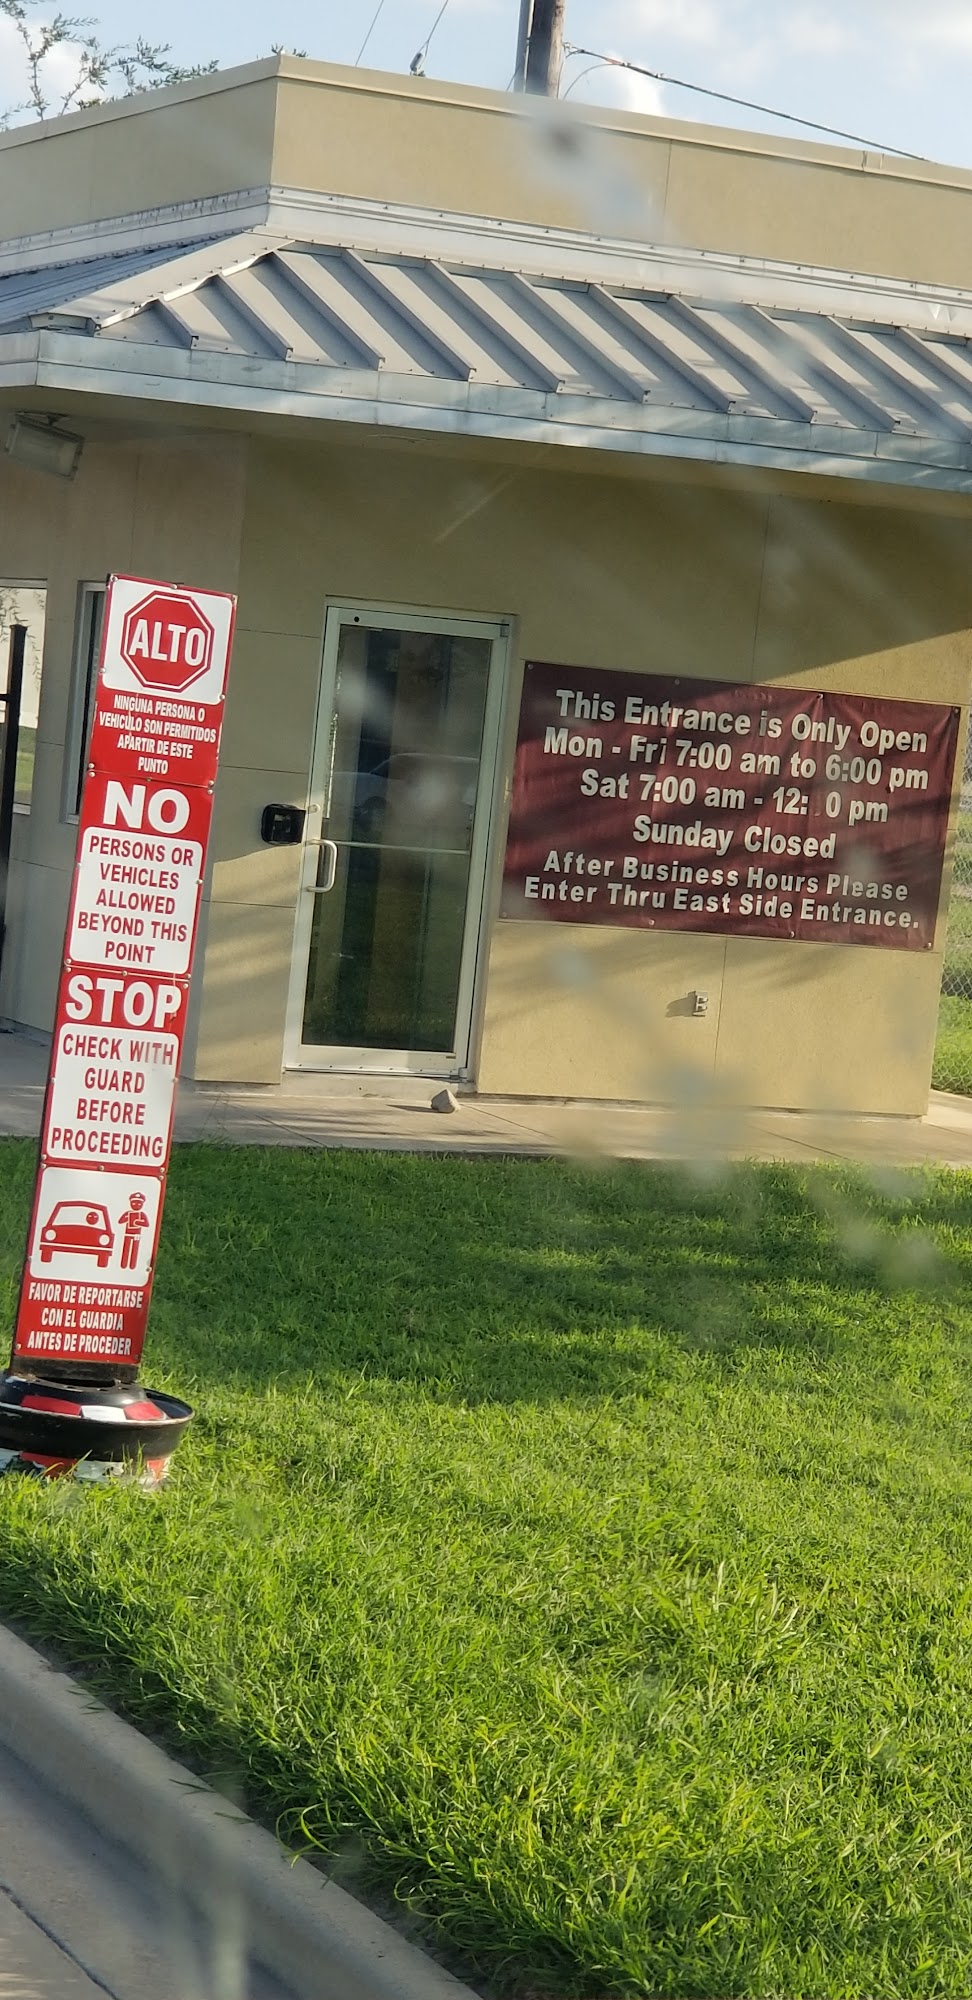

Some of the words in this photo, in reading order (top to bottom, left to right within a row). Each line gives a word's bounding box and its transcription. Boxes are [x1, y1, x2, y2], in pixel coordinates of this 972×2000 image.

[129, 618, 205, 666] ALTO
[100, 712, 142, 732] VEHICULO
[144, 718, 163, 735] SON
[164, 722, 216, 743] PERMITIDOS
[155, 703, 195, 720] PERSONA
[198, 709, 204, 722] O
[556, 689, 616, 722] This
[624, 696, 751, 735] Entrance
[759, 710, 783, 738] is
[792, 713, 851, 751] Only
[860, 721, 928, 755] Open
[157, 740, 169, 755] DE
[170, 743, 193, 758] ESTE
[543, 726, 602, 758] Mon
[629, 735, 667, 765] Fri
[675, 739, 732, 771] 7:00
[740, 752, 780, 776] am
[791, 752, 817, 778] to
[826, 754, 882, 785] 6:00
[889, 766, 928, 793] pm
[138, 757, 168, 774] PUNTO
[102, 780, 190, 834] NO
[581, 768, 630, 800] Sat
[639, 773, 696, 805] 7:00
[704, 786, 746, 811] am
[849, 799, 889, 826] pm
[89, 835, 165, 862] PERSONS
[171, 847, 193, 866] OR
[633, 815, 734, 856] Sunday
[744, 825, 836, 858] Closed
[100, 863, 179, 889] VEHICLES
[543, 850, 615, 877] After
[622, 856, 740, 887] Business
[747, 866, 819, 895] Hours
[826, 874, 908, 901] Please
[96, 889, 175, 914] ALLOWED
[524, 876, 597, 903] Enter
[607, 883, 665, 908] Thru
[673, 888, 731, 914] East
[739, 893, 793, 919] Side
[800, 898, 919, 929] Entrance.
[78, 912, 144, 936] BEYOND
[151, 921, 187, 942] THIS
[105, 941, 155, 963] POINT
[65, 974, 182, 1028] STOP
[63, 1034, 123, 1060] CHECK
[130, 1040, 174, 1065] WITH
[85, 1068, 145, 1093] GUARD
[77, 1098, 146, 1125] BEFORE
[51, 1127, 163, 1157] PROCEEDING
[29, 1282, 61, 1302] FAVOR
[63, 1285, 77, 1304] DE
[78, 1287, 144, 1308] REPORTARSE
[41, 1308, 63, 1326] CON
[65, 1310, 76, 1327] EL
[80, 1311, 123, 1330] GUARDIA
[27, 1331, 62, 1350] ANTES
[63, 1333, 77, 1351] DE
[78, 1335, 131, 1355] PROCEDER
